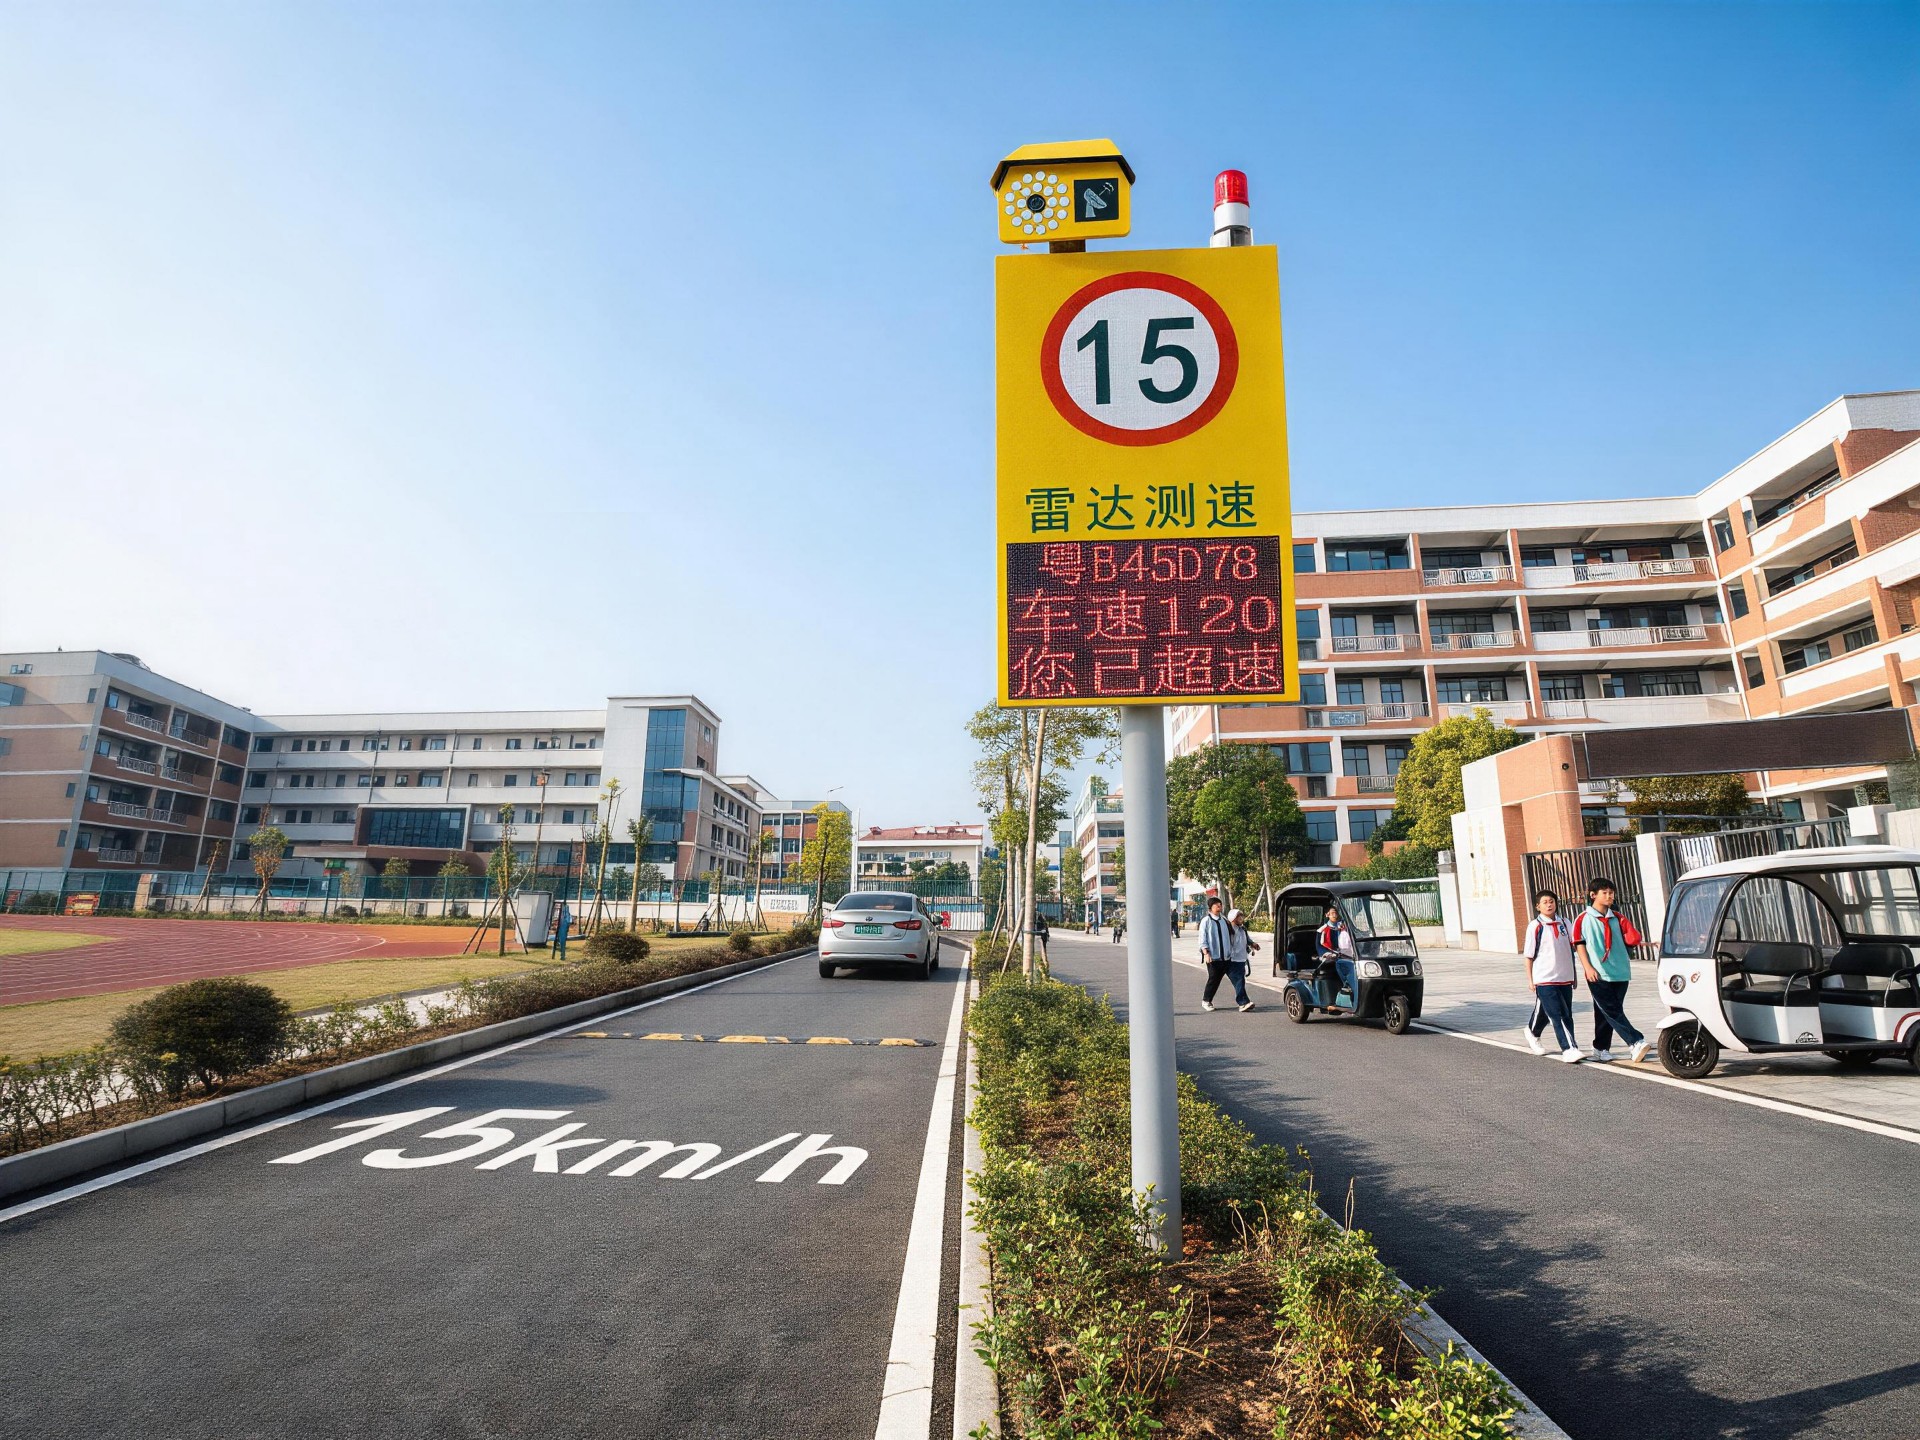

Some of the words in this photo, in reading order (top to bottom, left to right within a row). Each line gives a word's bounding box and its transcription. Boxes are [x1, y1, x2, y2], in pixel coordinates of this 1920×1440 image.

[1077, 316, 1199, 405] 15
[1025, 481, 1258, 533] 雷达测速
[1038, 542, 1258, 585] 粤B45D78
[1010, 642, 1282, 696] 您已超速
[267, 1106, 868, 1185] 15km/h
